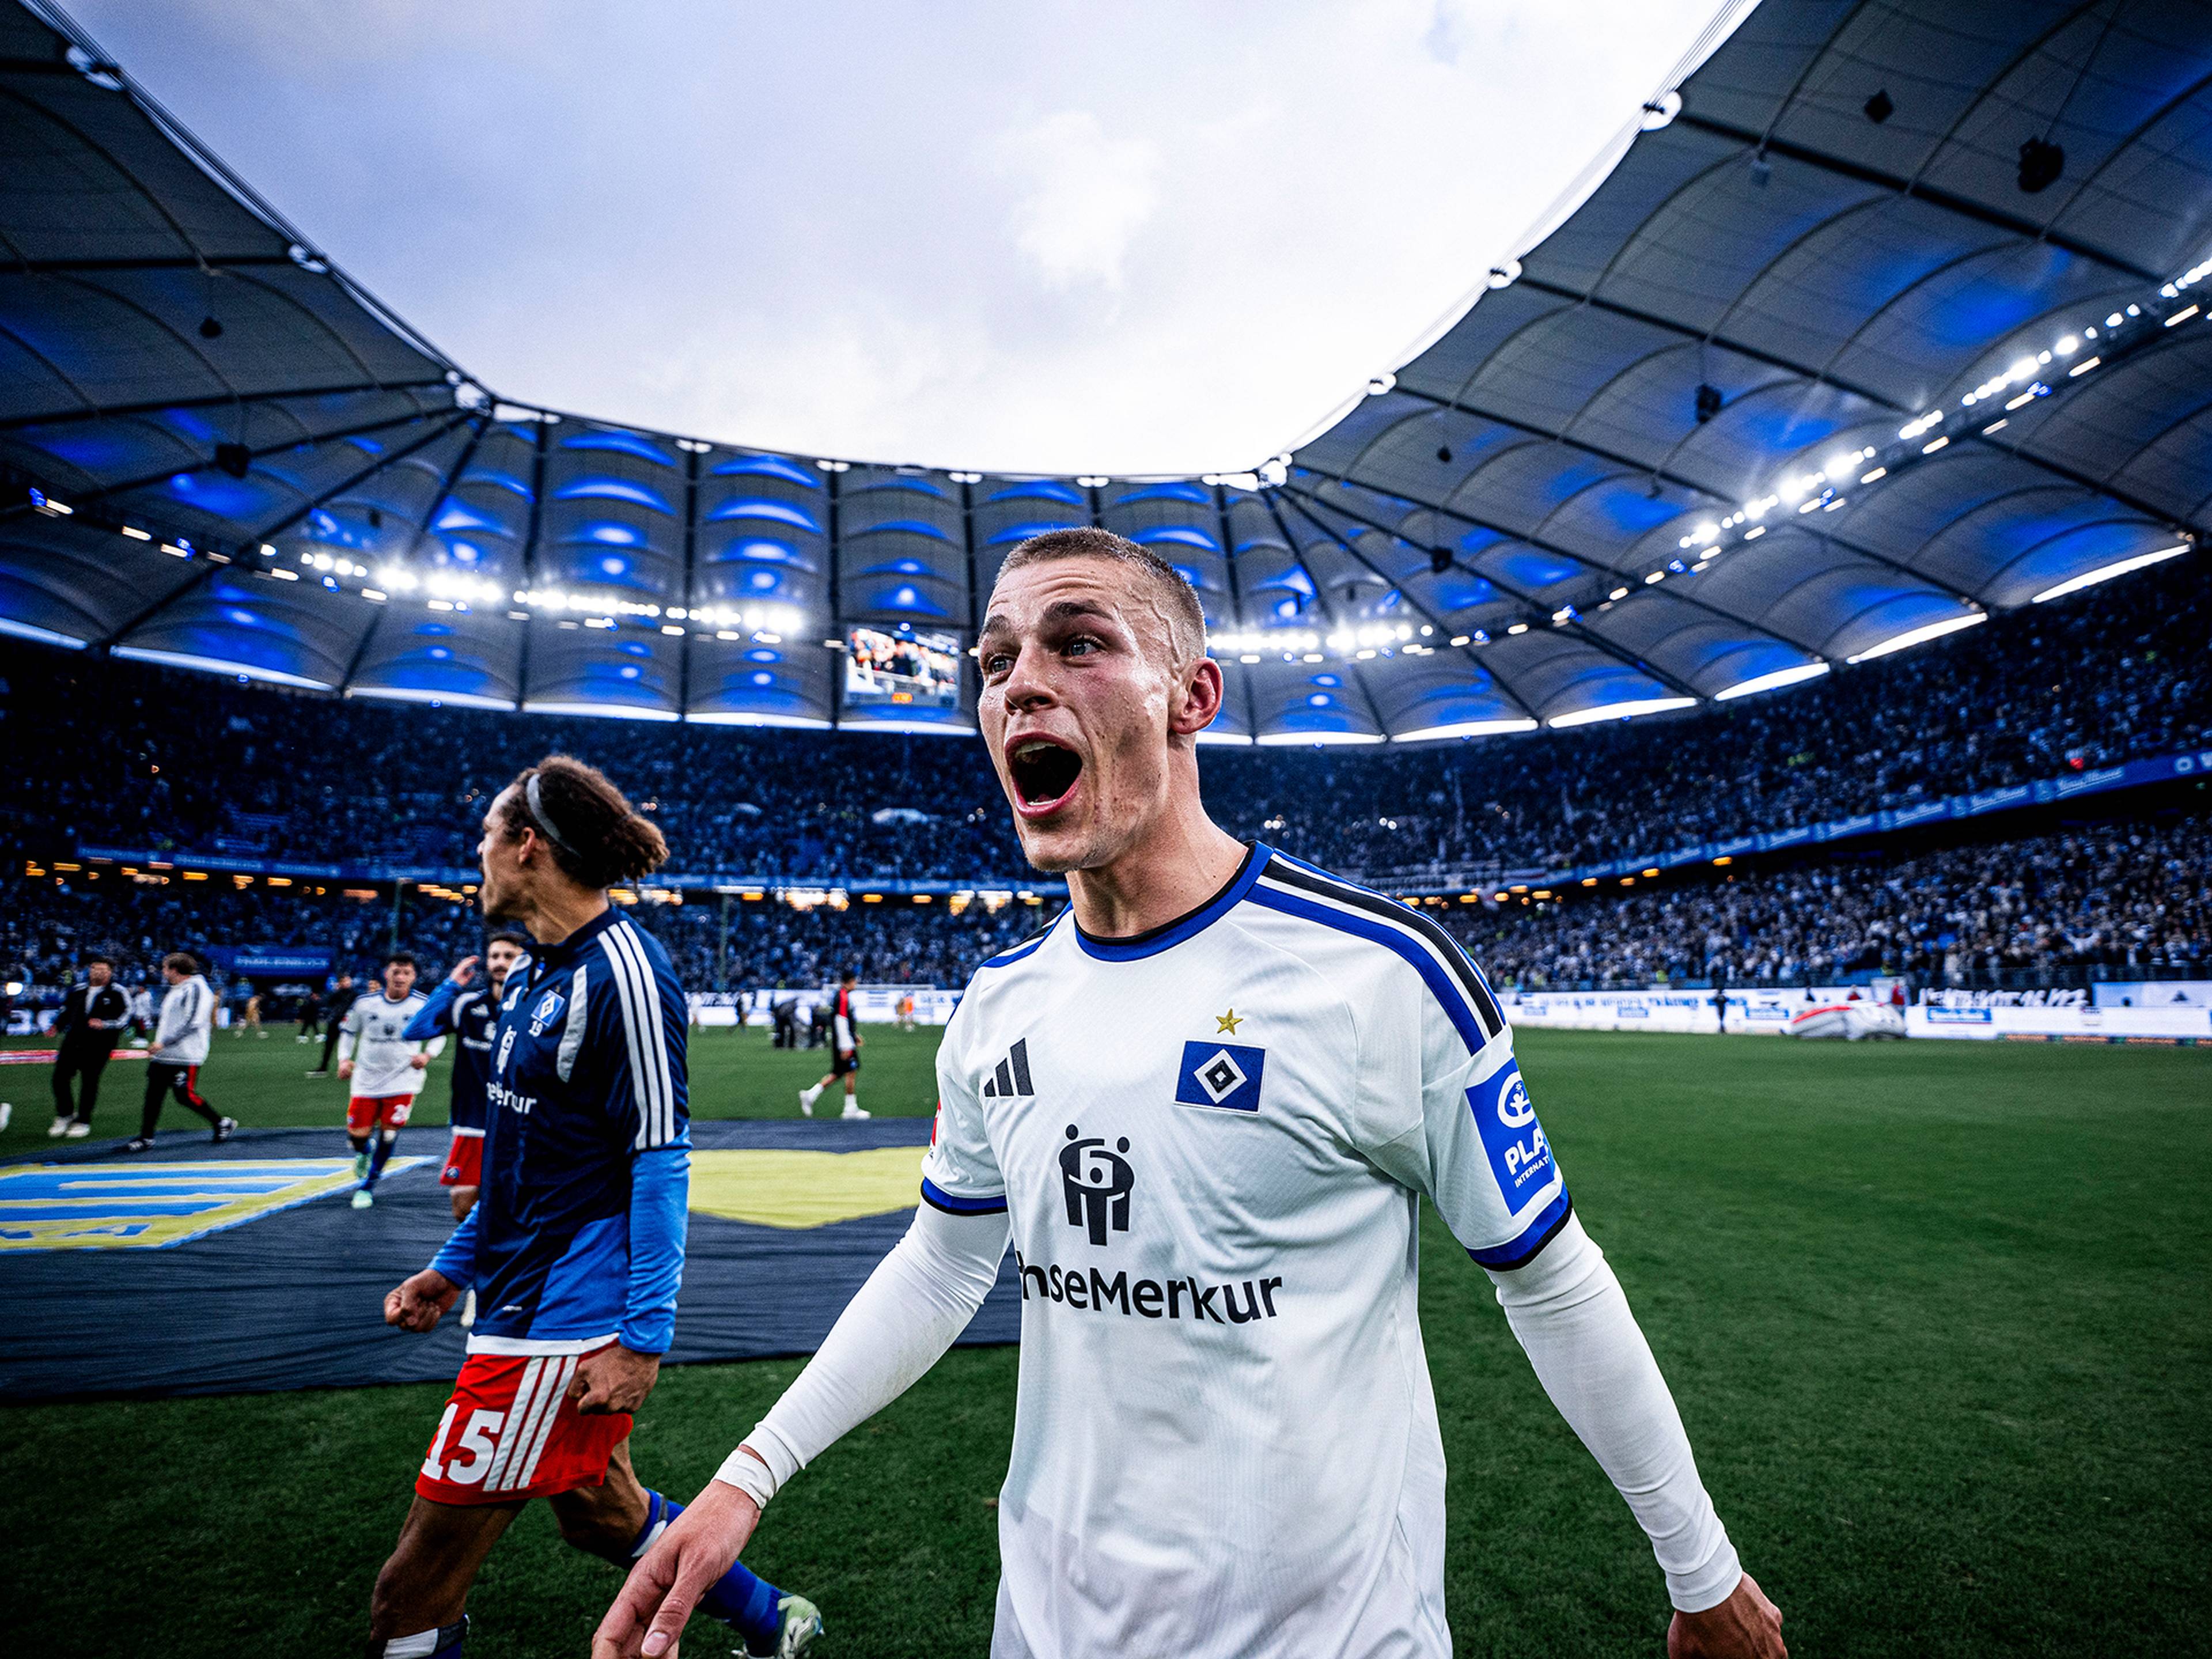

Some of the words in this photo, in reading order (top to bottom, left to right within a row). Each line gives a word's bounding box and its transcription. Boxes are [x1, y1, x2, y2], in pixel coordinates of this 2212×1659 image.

[1504, 1126, 1549, 1176] PLA
[1514, 1155, 1550, 1188] INTERNAT
[1016, 1251, 1282, 1324] nseMerkur
[421, 1402, 505, 1484] 15
